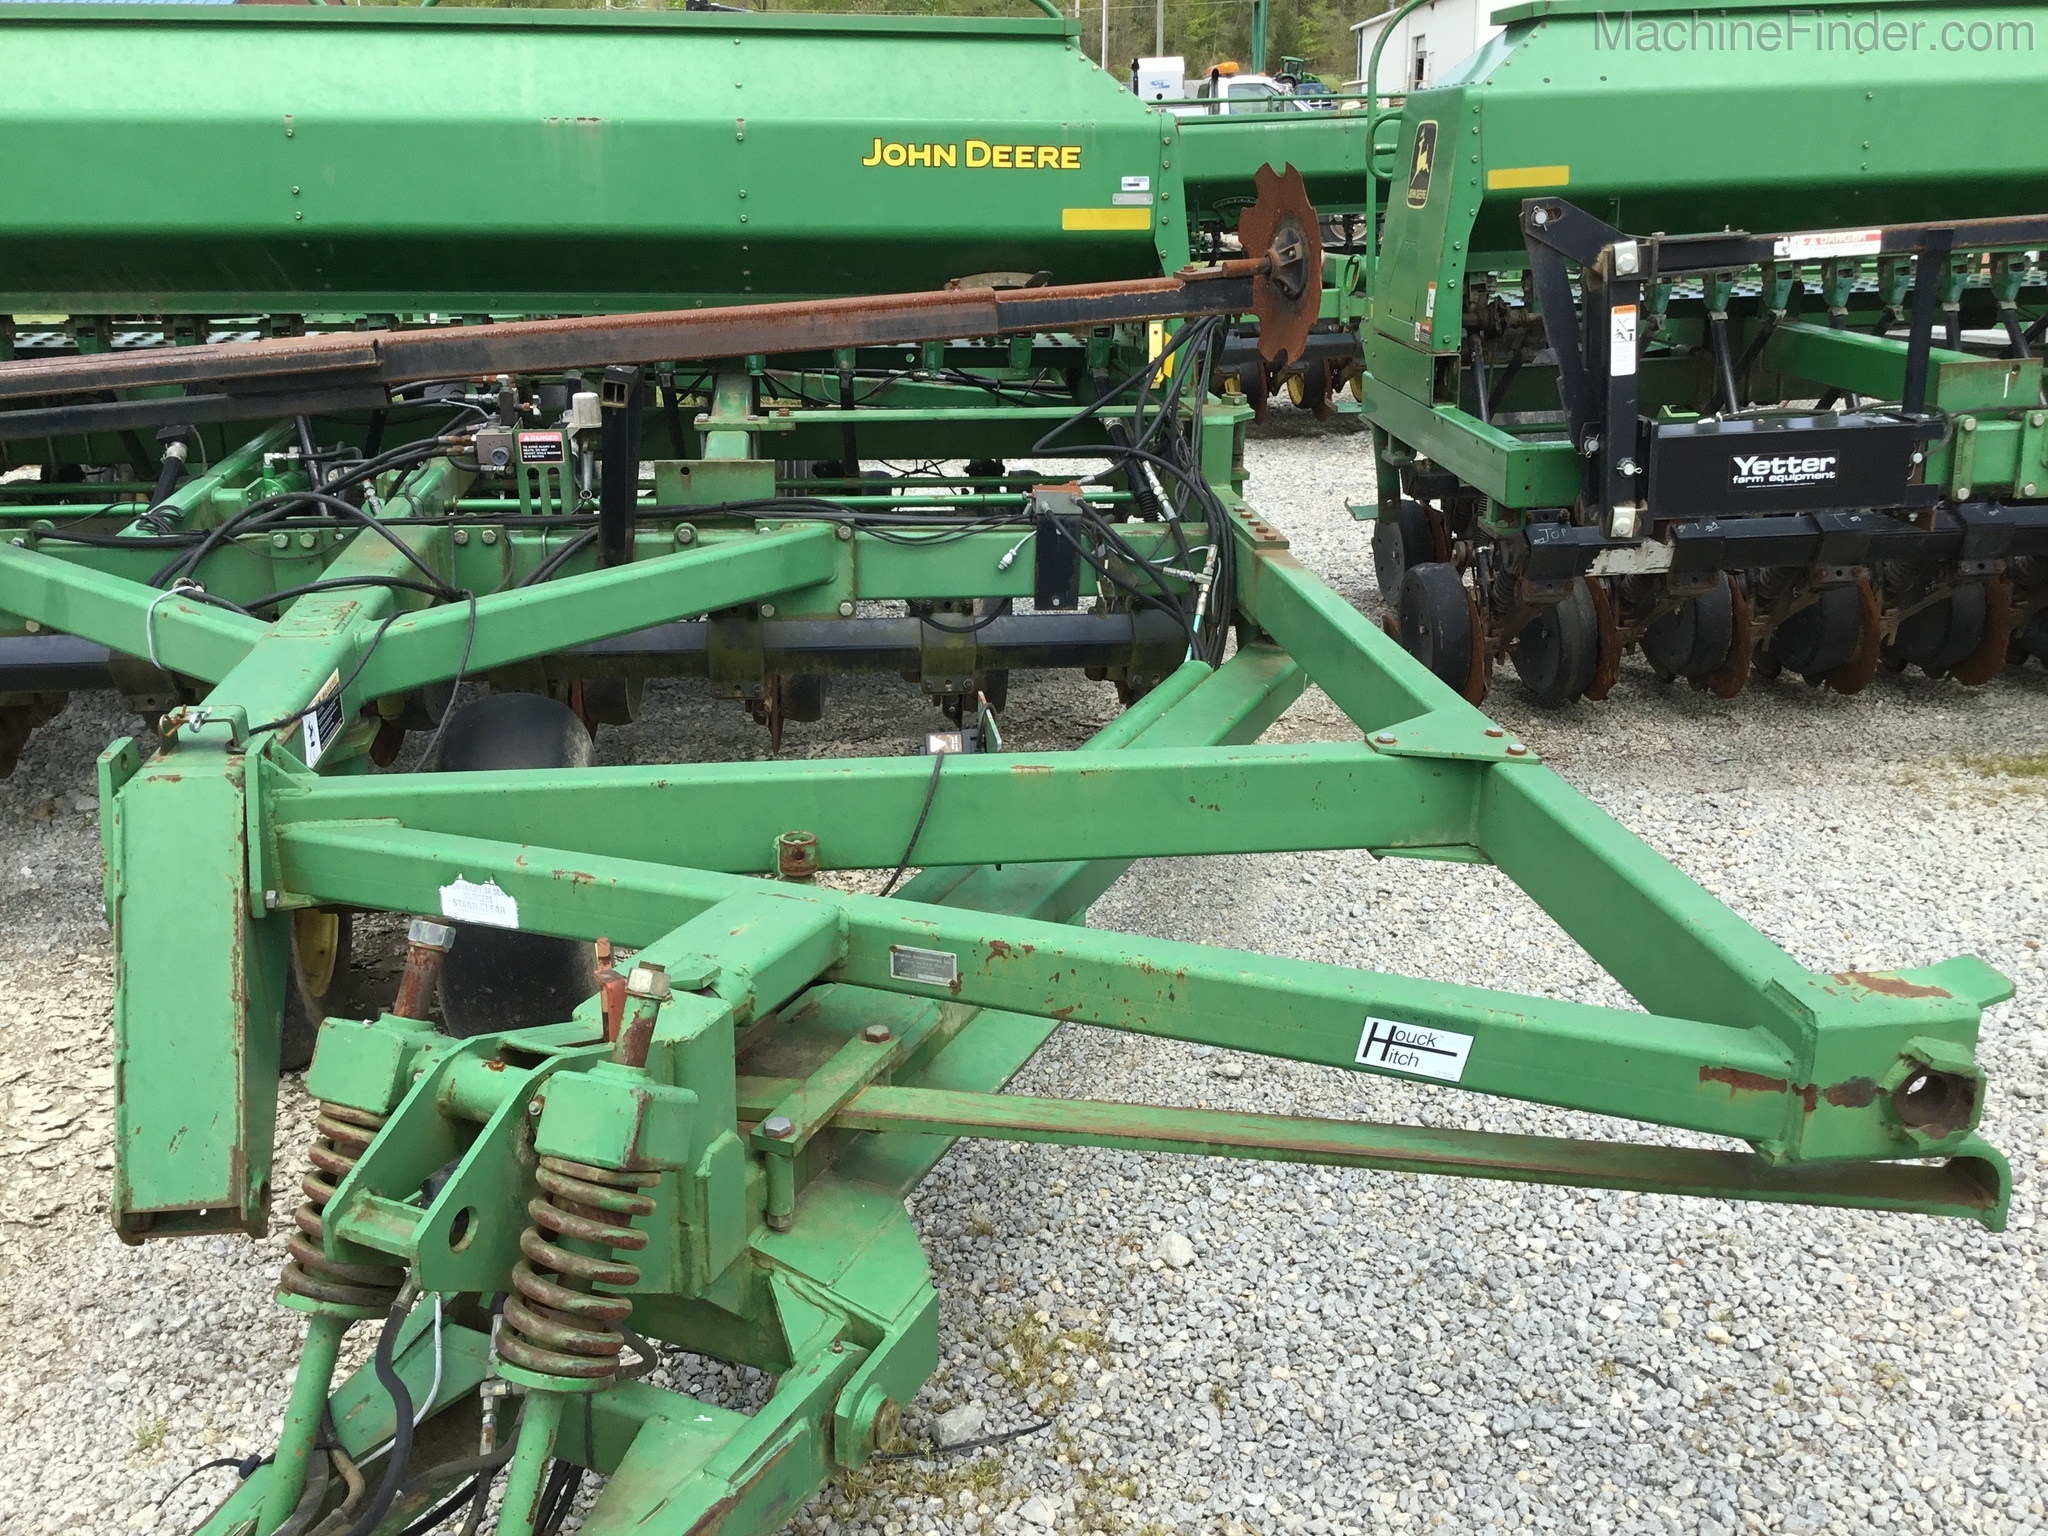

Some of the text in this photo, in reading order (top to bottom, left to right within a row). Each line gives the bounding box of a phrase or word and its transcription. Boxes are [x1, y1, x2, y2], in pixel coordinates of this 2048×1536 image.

[862, 138, 1082, 169] JOHN DEERE
[1821, 234, 1866, 245] DANGER
[1733, 456, 1836, 476] Yetter
[1733, 471, 1836, 484] farm equipment
[452, 898, 478, 910] STAND
[480, 902, 506, 914] CLEAR
[1362, 1022, 1437, 1057] Houck
